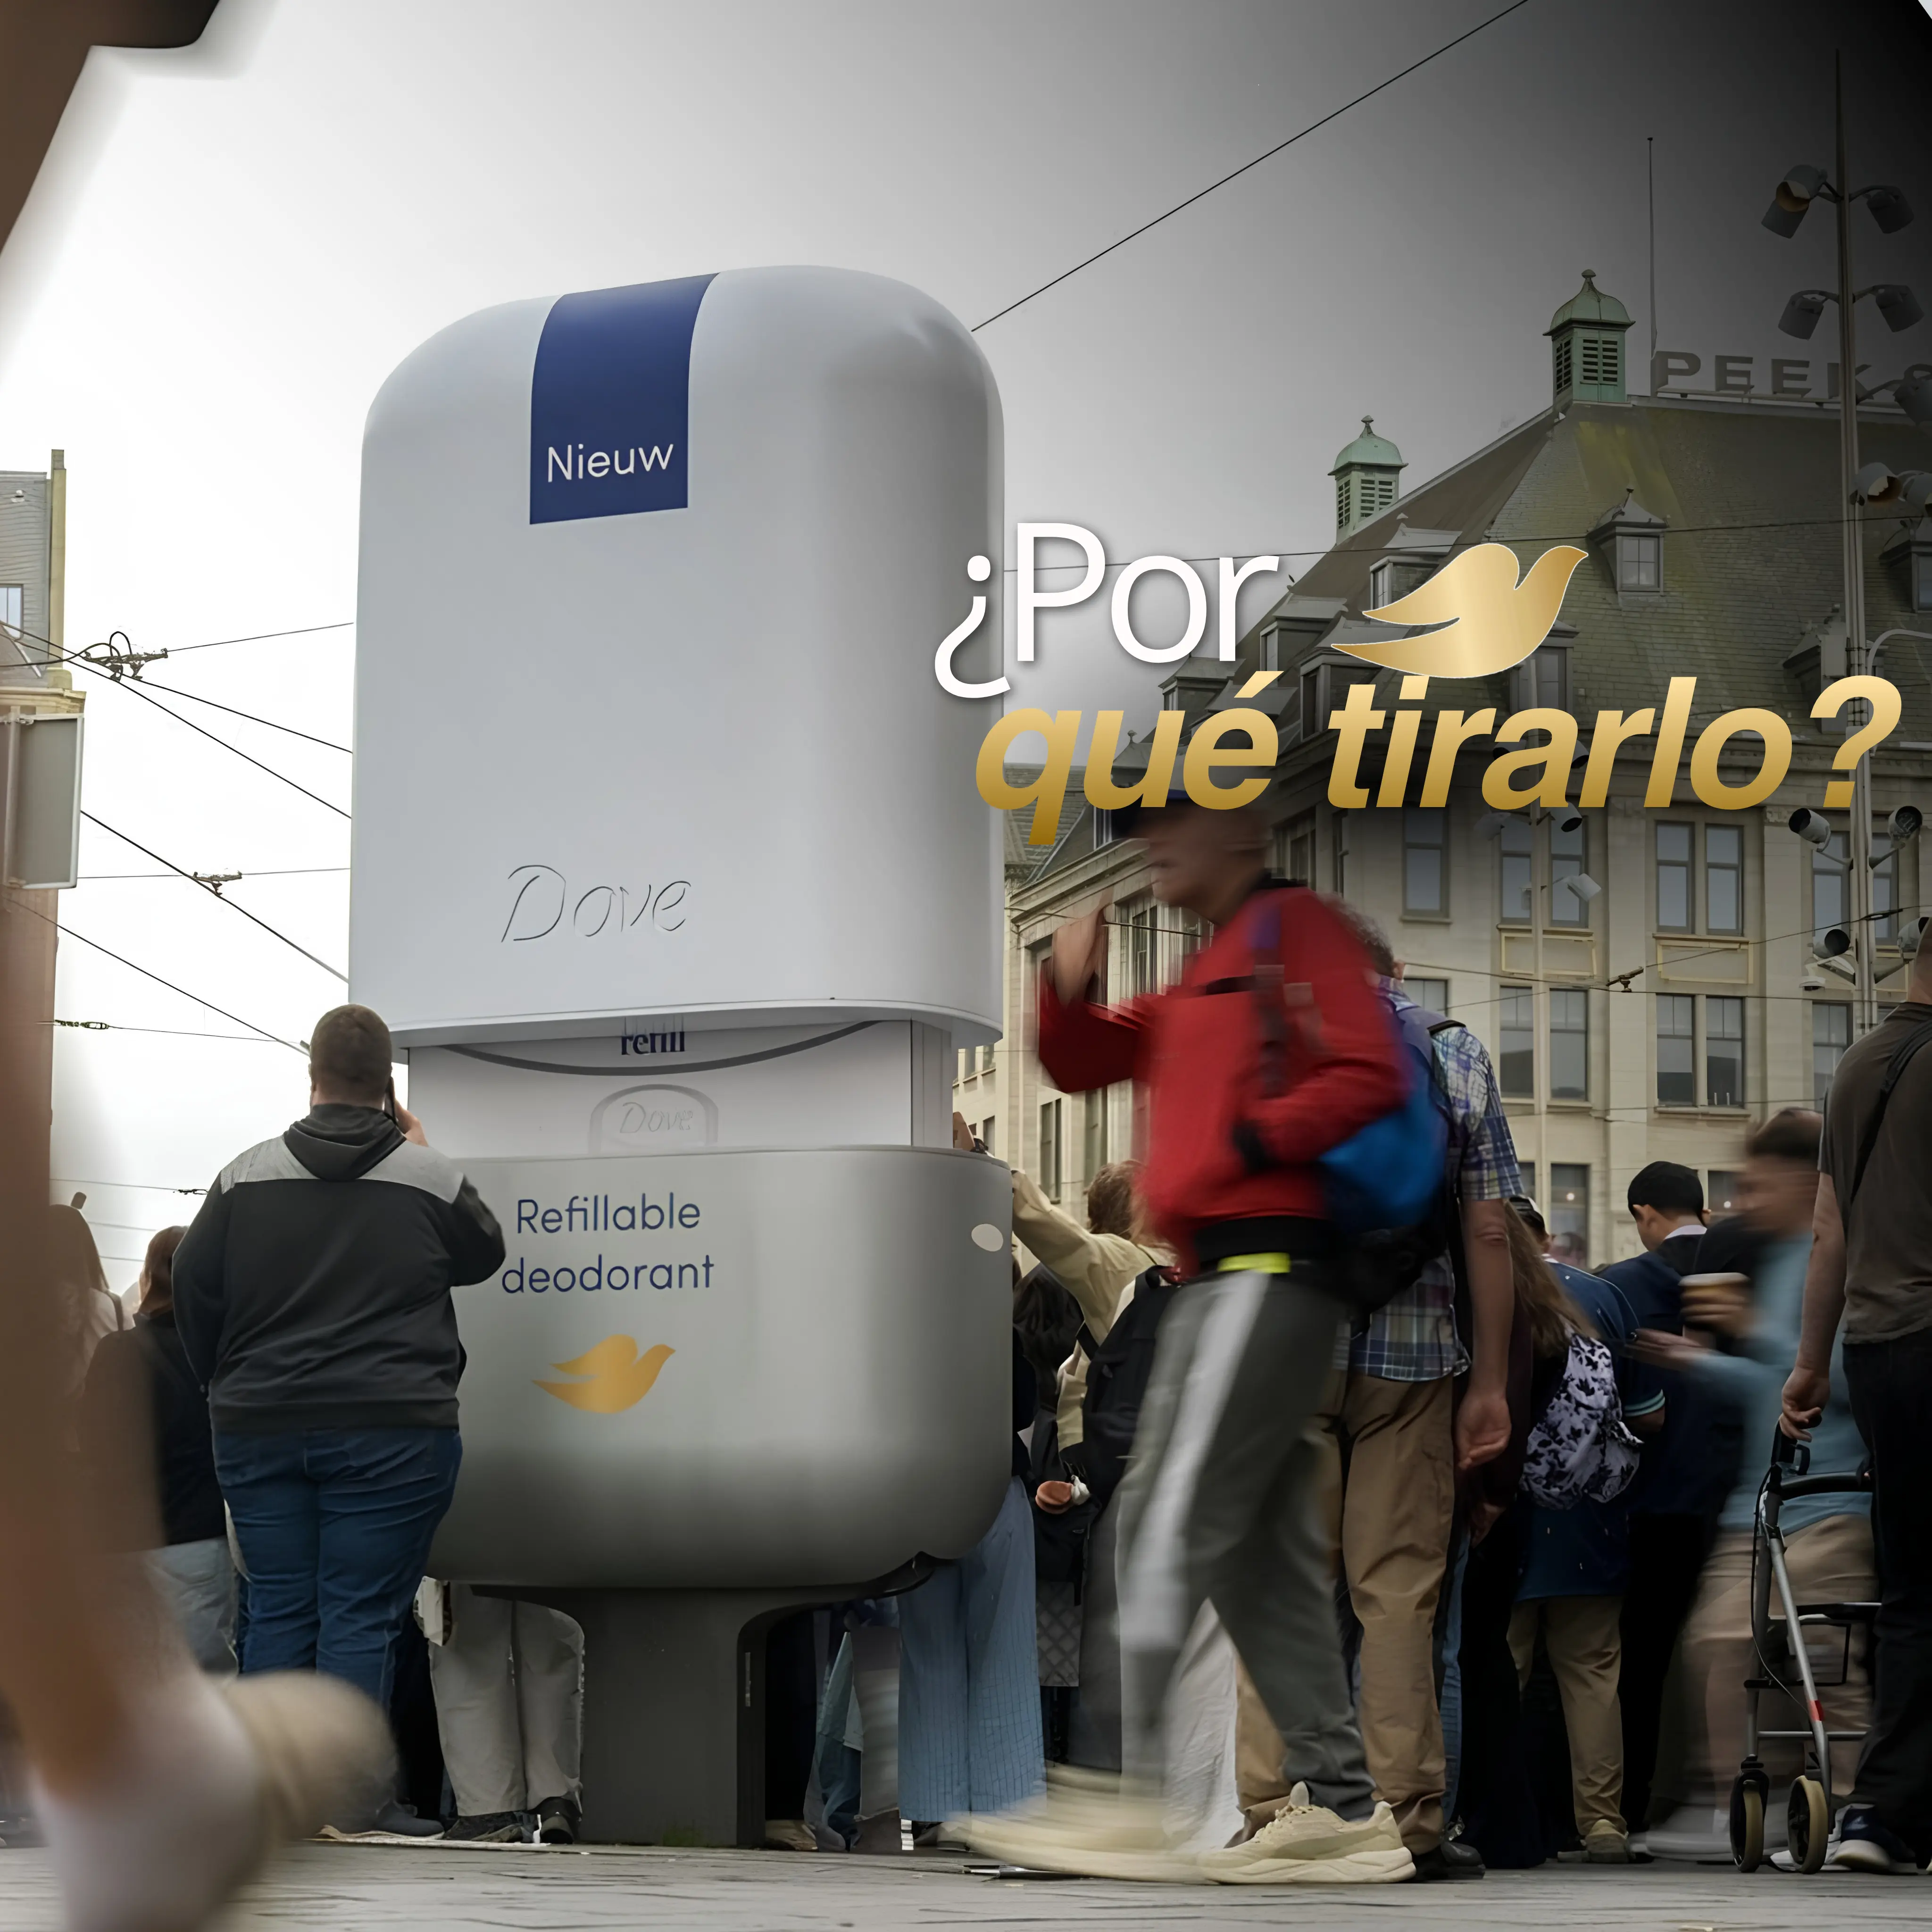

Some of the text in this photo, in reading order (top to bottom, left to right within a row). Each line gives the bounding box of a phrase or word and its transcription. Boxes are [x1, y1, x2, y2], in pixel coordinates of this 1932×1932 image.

[548, 443, 674, 483] Nieuw
[501, 865, 691, 943] Dove
[619, 1102, 693, 1133] Dove
[517, 1191, 701, 1234] Refillable
[501, 1253, 715, 1295] deodorant
